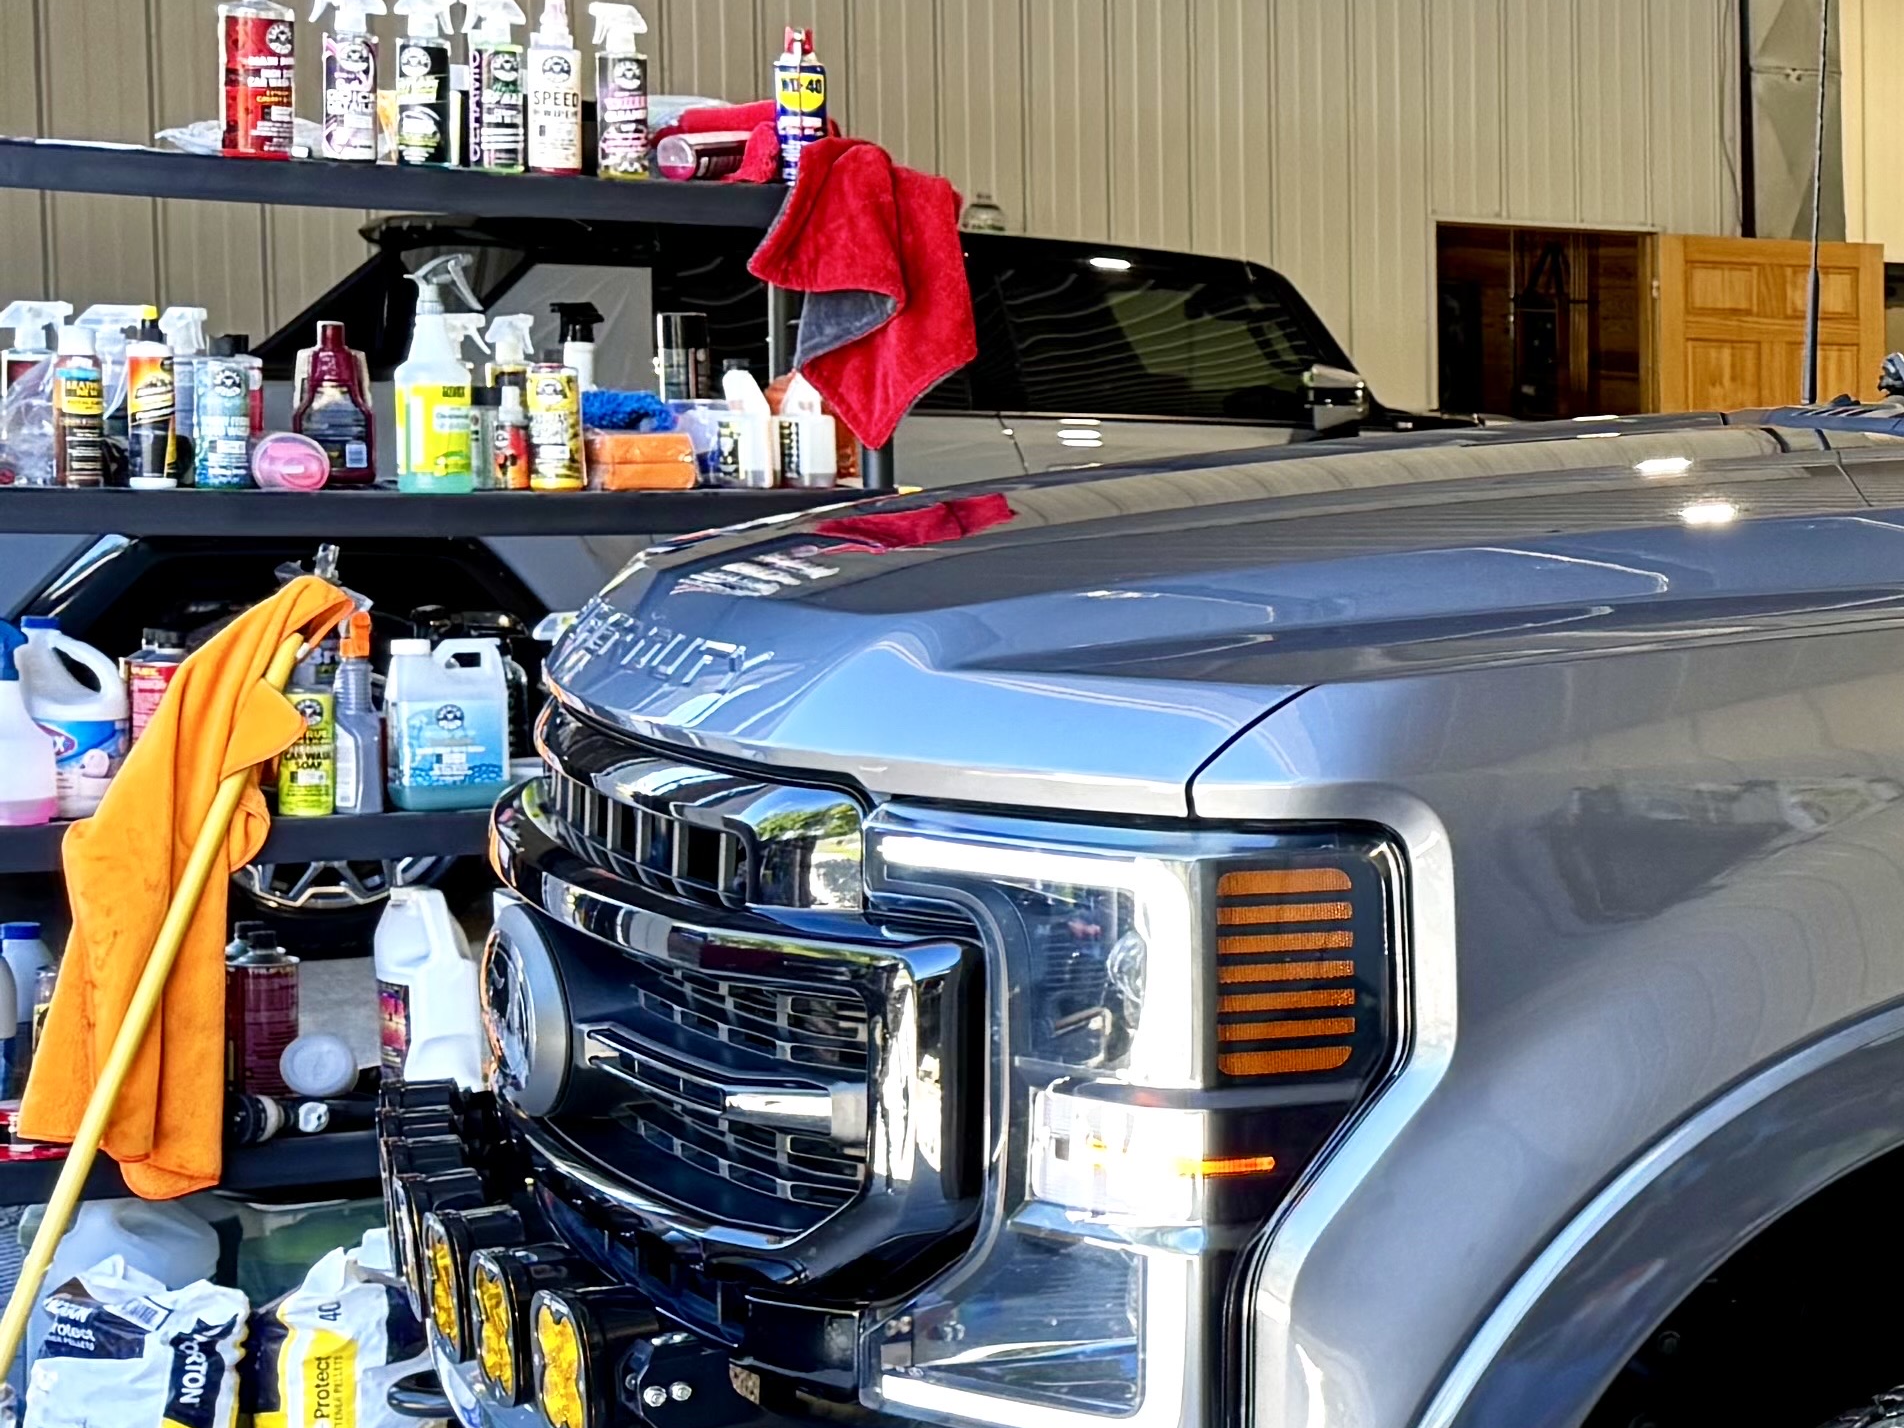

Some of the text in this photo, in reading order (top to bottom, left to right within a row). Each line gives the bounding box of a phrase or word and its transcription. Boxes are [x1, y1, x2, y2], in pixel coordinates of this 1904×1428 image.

[533, 90, 579, 108] SPEED
[313, 1355, 332, 1419] Protect
[333, 1355, 344, 1394] PELLETS
